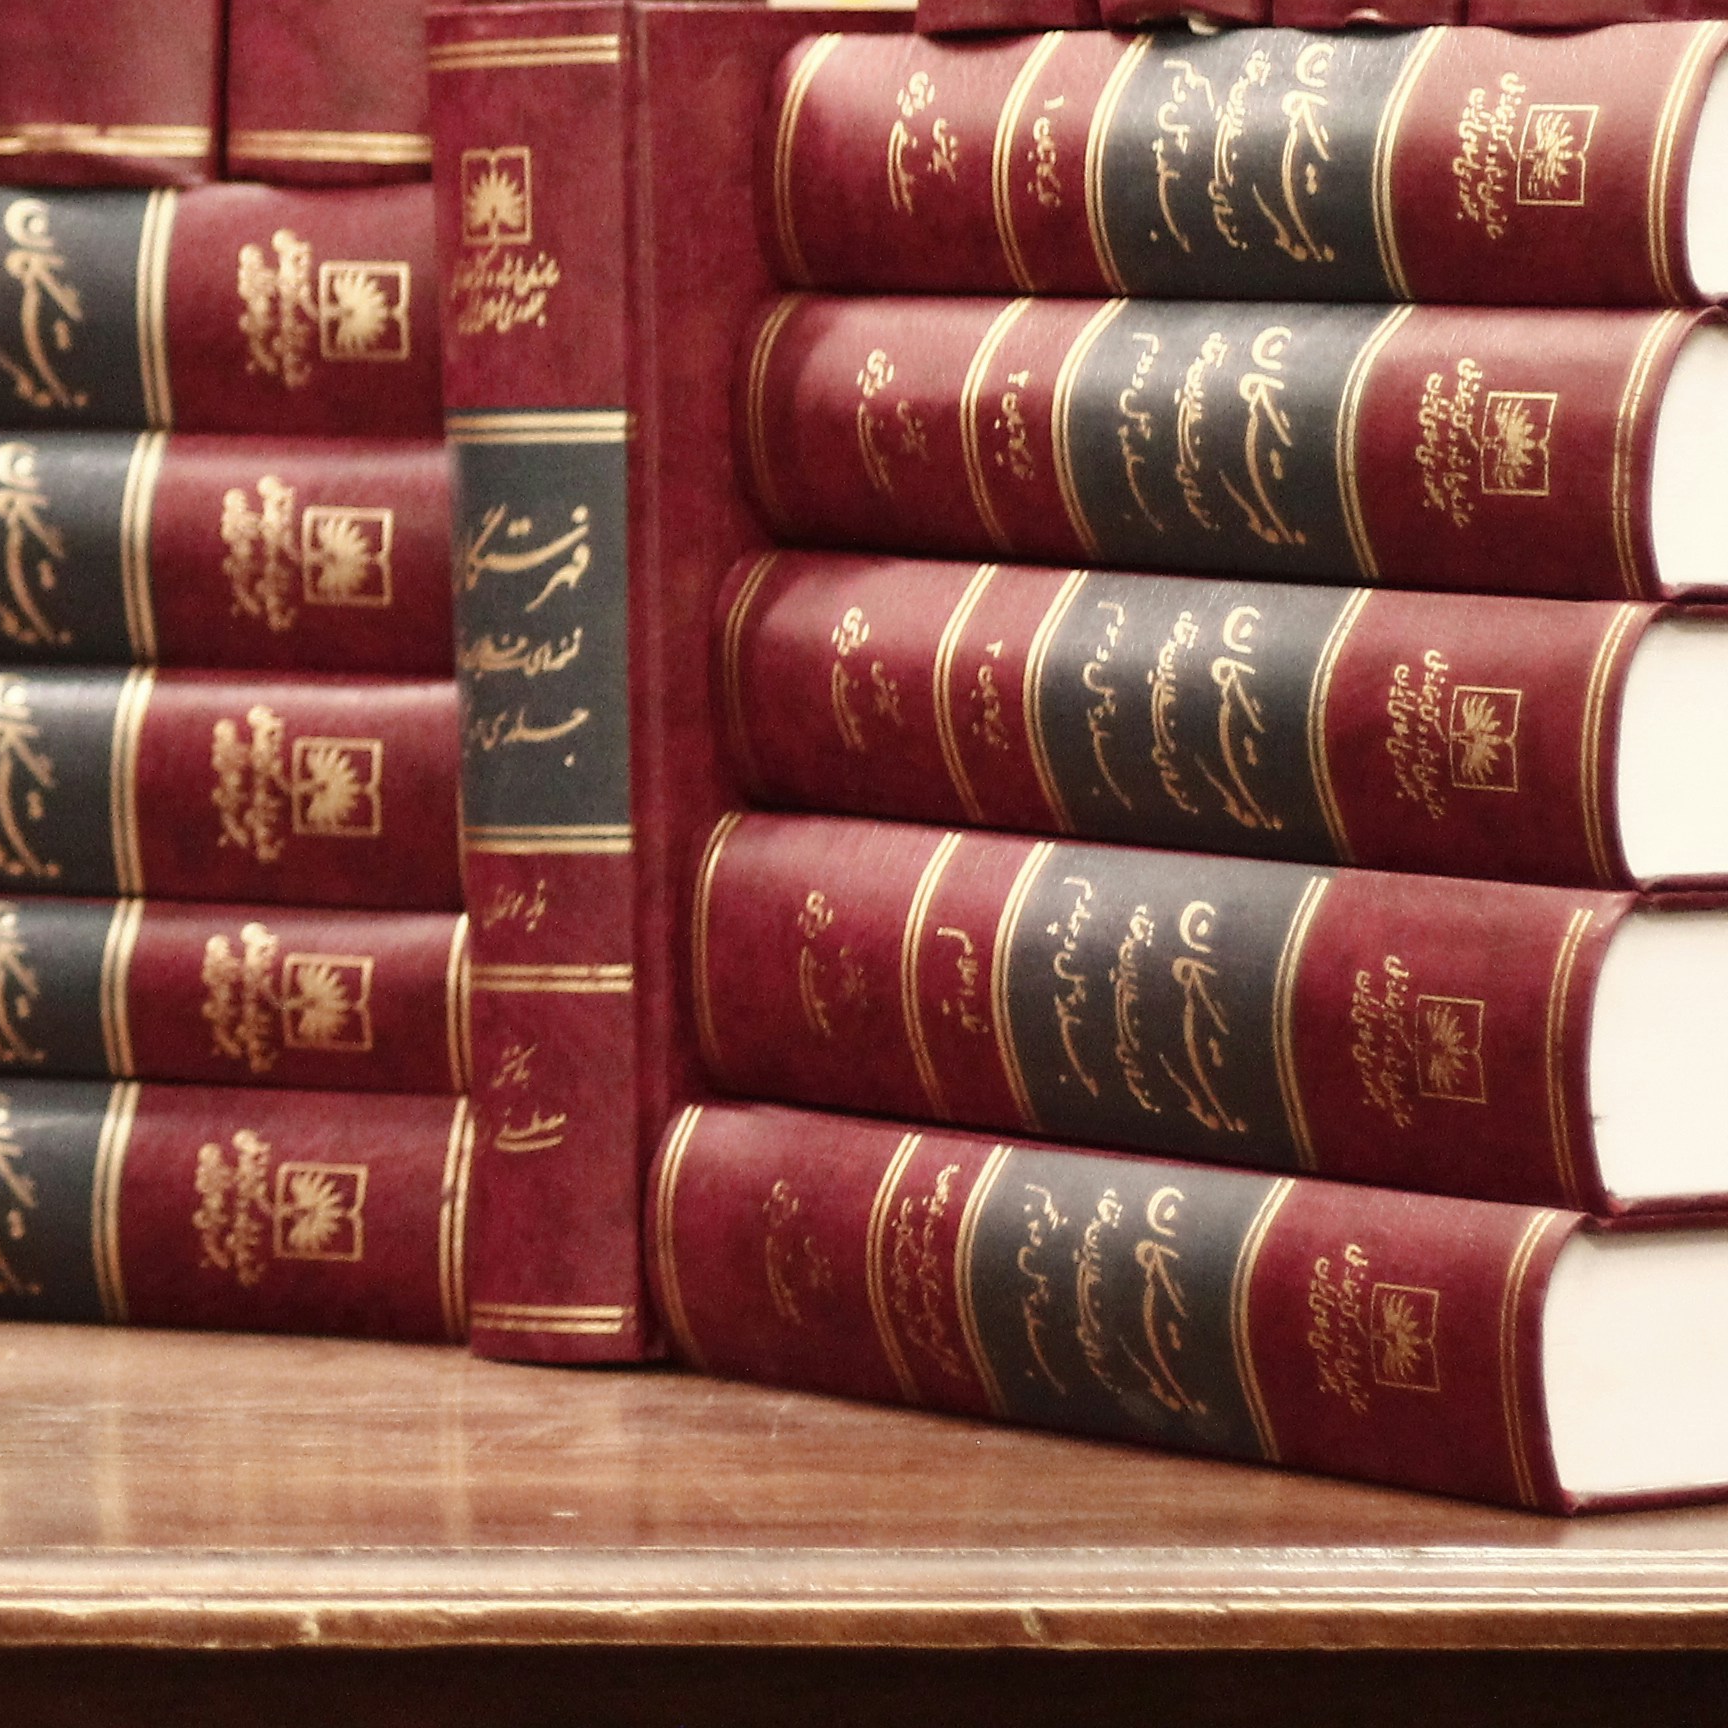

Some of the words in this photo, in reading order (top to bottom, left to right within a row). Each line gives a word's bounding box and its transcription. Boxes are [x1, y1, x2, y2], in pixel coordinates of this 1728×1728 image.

[1281, 41, 1336, 264] فهرستگان
[1238, 325, 1307, 546] فهرستگان
[1210, 605, 1284, 831] فهرستگان
[1170, 899, 1248, 1134] فهرستگان
[1134, 1185, 1209, 1415] فهرستگان
